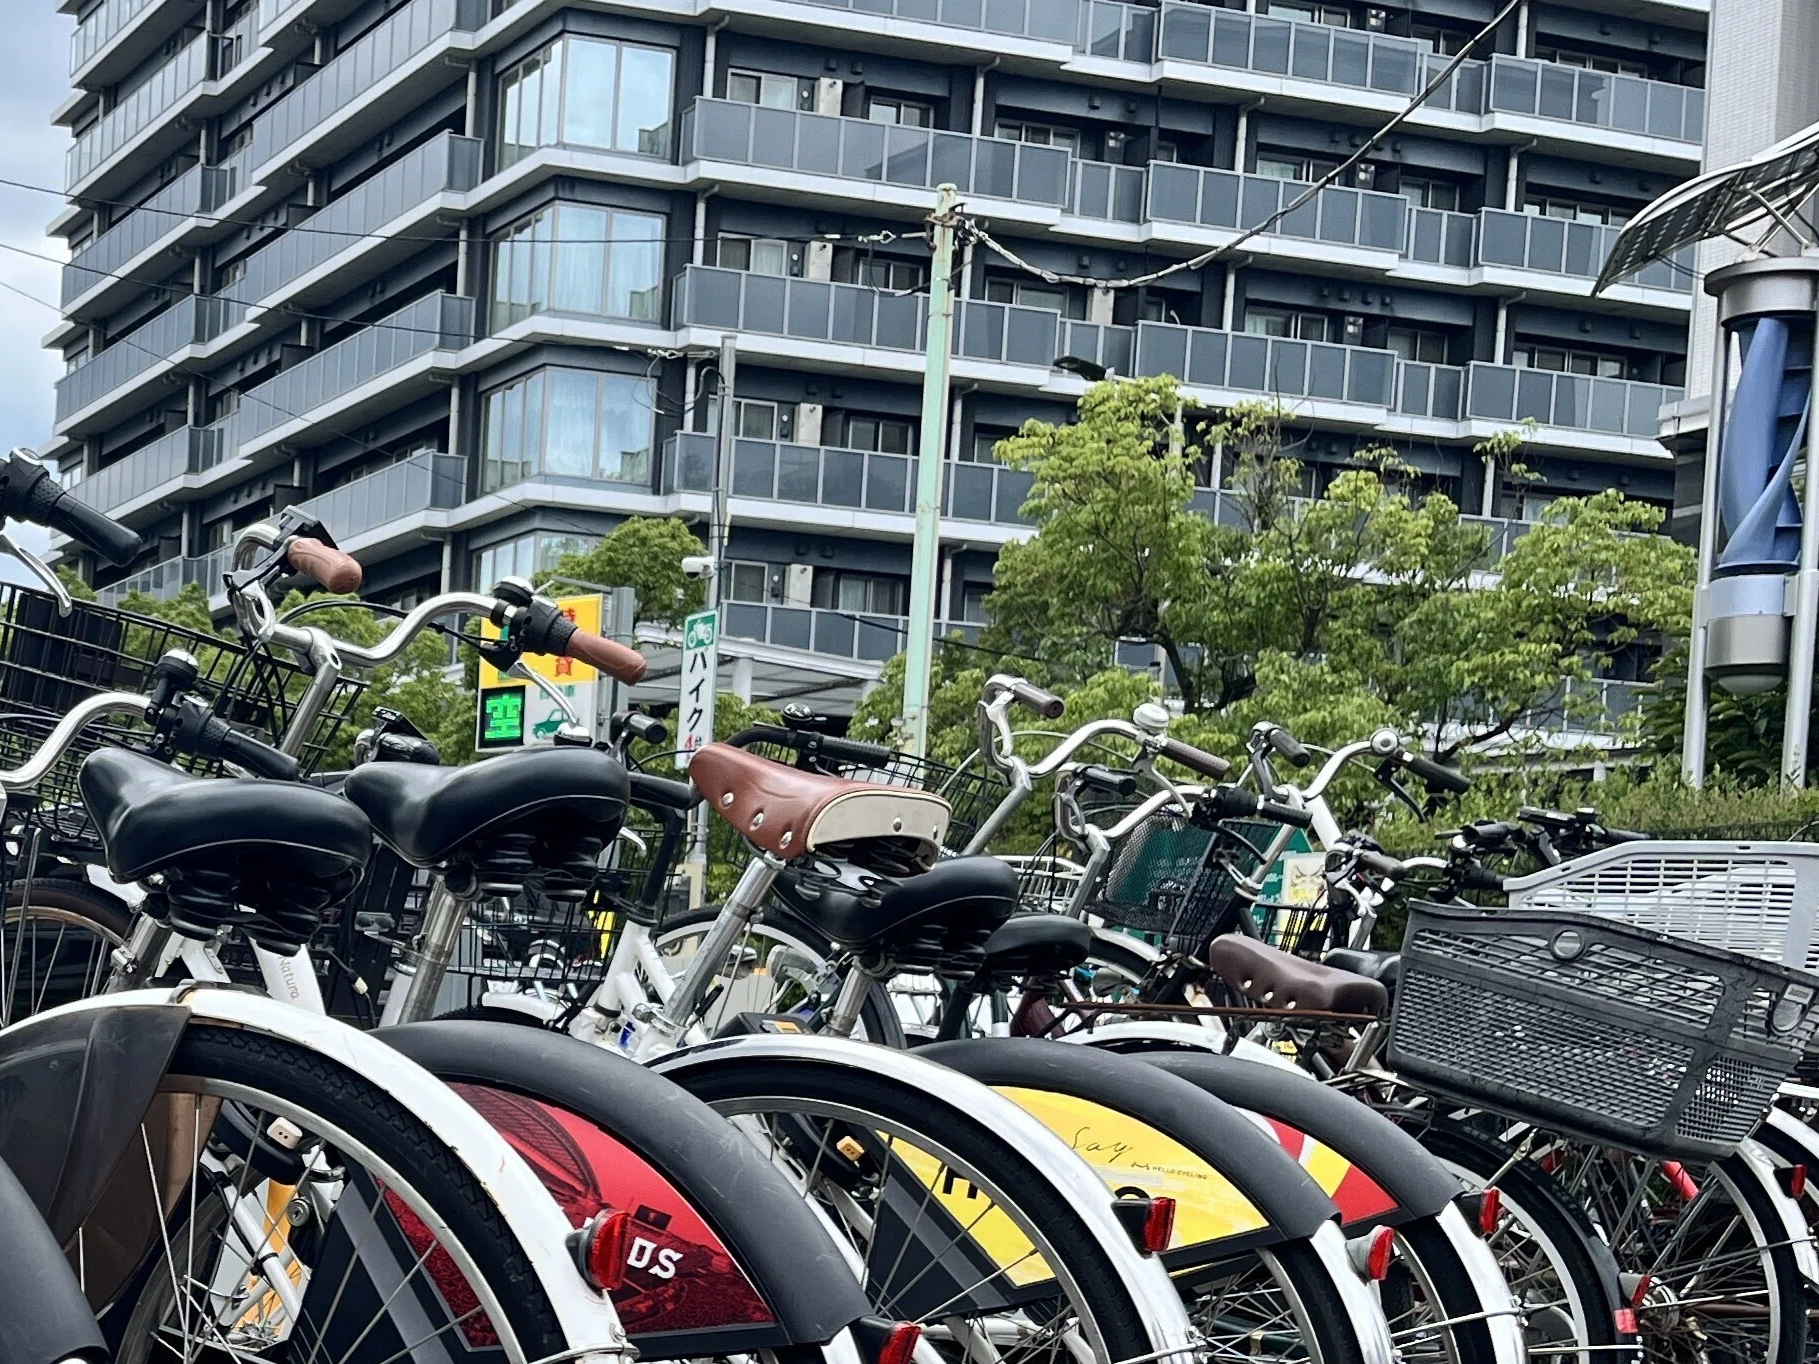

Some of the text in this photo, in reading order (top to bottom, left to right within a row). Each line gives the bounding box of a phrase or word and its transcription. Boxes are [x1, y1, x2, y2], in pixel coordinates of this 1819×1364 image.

[686, 647, 708, 732] バイク
[484, 694, 522, 739] 空
[1071, 1126, 1134, 1164] Say
[1152, 1166, 1176, 1175] HELLO
[626, 1236, 684, 1279] DS
